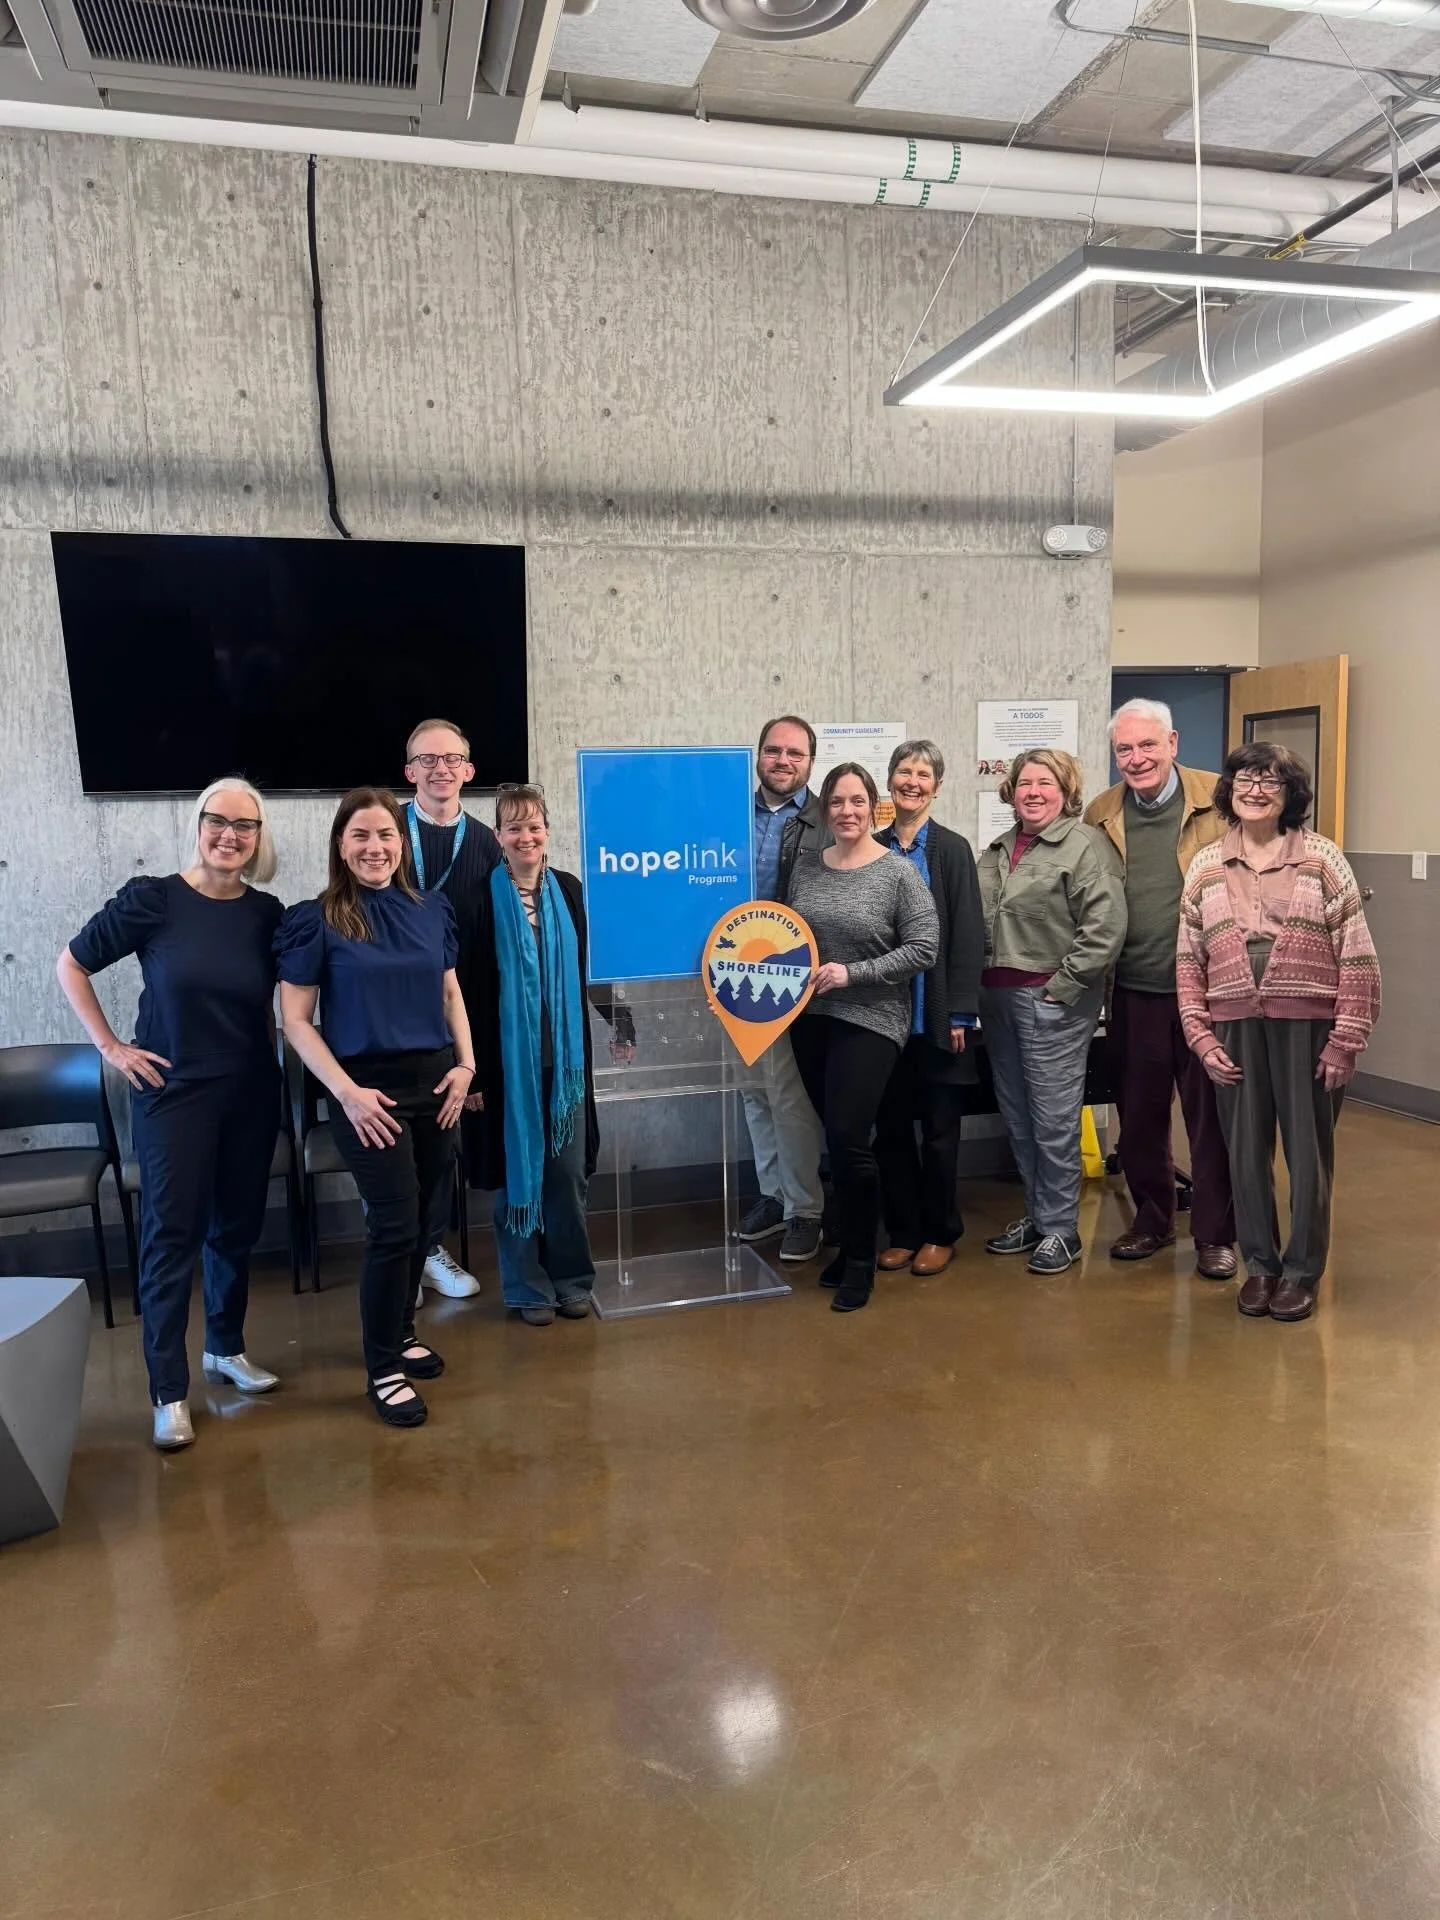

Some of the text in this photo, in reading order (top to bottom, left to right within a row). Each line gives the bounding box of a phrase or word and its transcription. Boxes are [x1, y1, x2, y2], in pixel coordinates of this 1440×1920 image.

[1019, 711, 1045, 719] TODOS
[823, 727, 884, 735] COMMUNITY GUIDELINES
[599, 842, 738, 878] hopelink
[688, 874, 738, 885] Programs
[726, 909, 801, 938] DESTINATION
[717, 961, 801, 978] SHORELINE
